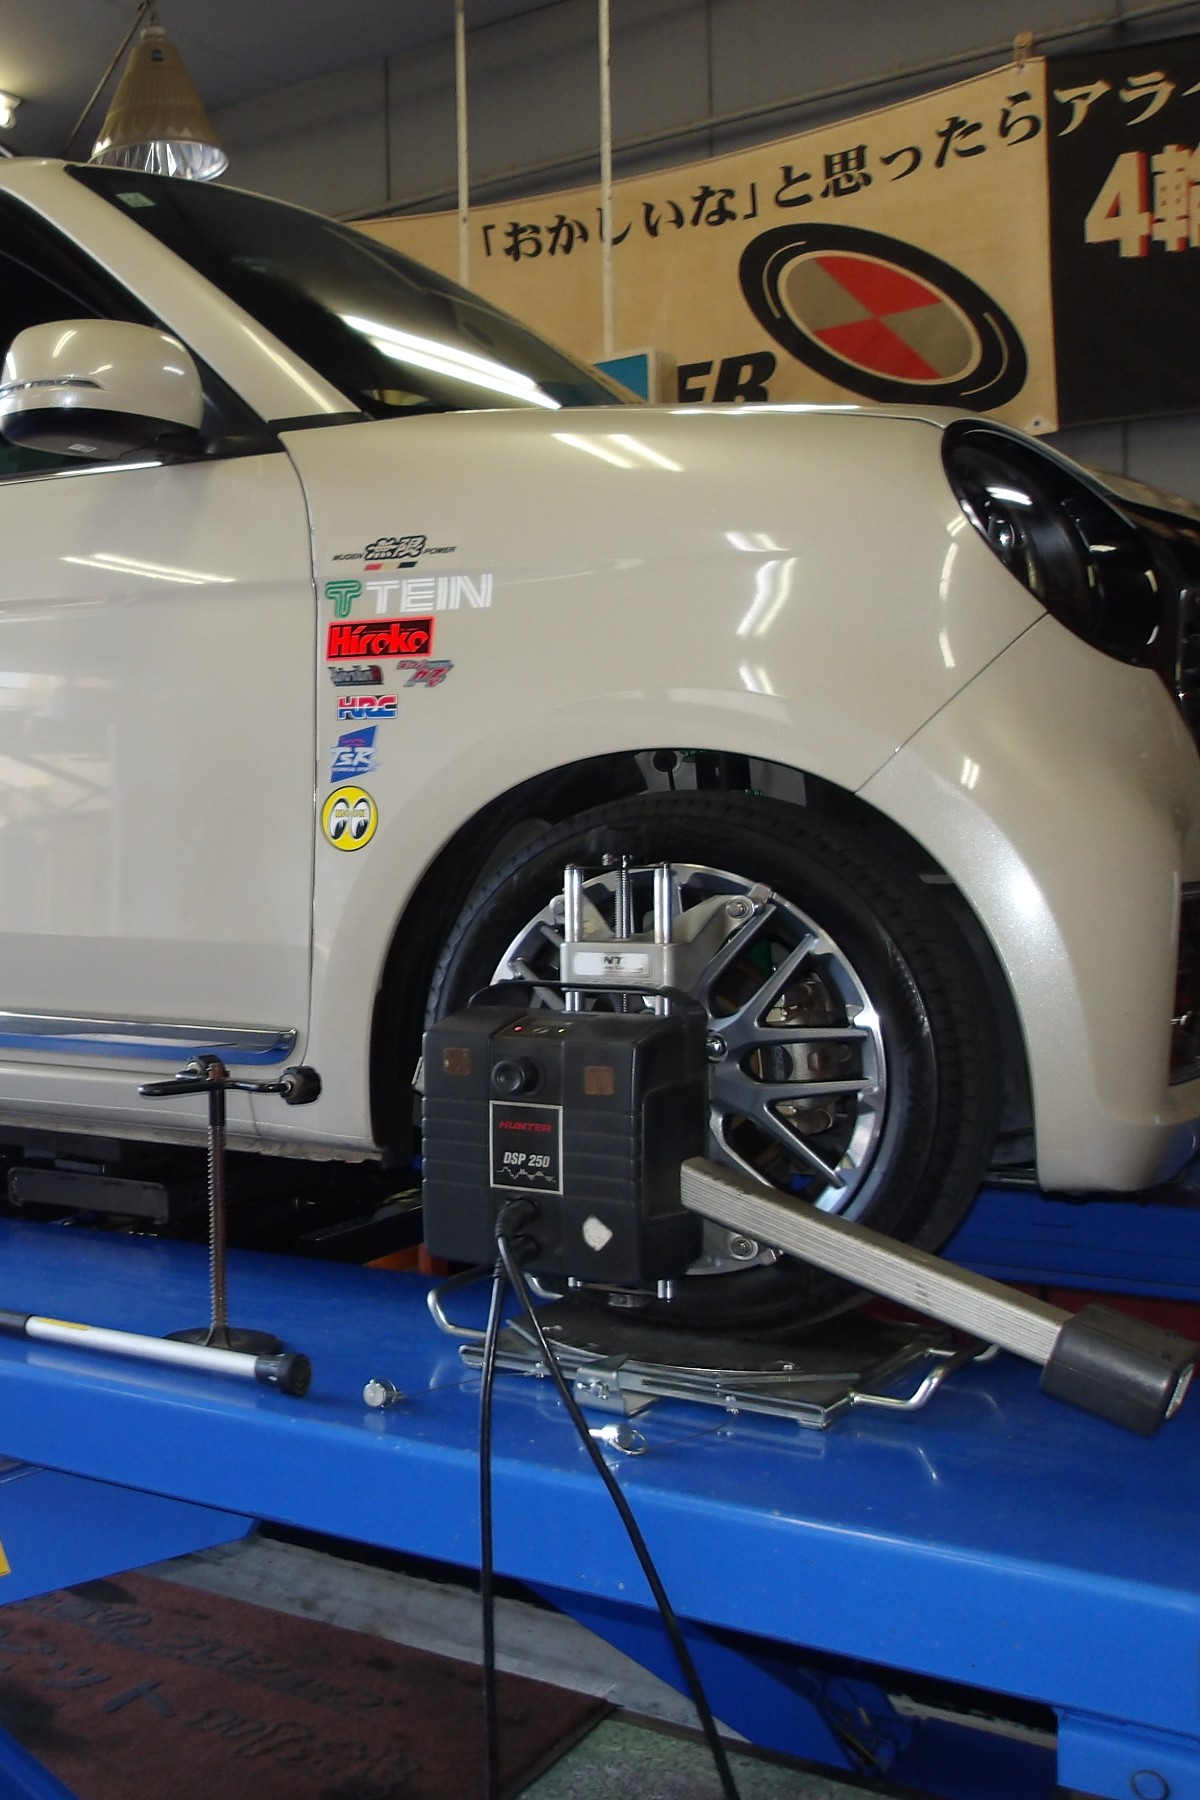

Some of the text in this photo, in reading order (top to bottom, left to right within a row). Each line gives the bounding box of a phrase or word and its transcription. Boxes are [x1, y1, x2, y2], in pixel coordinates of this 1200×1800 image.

[481, 71, 1200, 262] 「おかしいな」と思ったらアラ
[365, 573, 493, 615] TEIN
[329, 622, 429, 657] Hiroko
[337, 694, 398, 720] HRC
[499, 1120, 553, 1133] HUNTER
[503, 1151, 551, 1168] DSP 250
